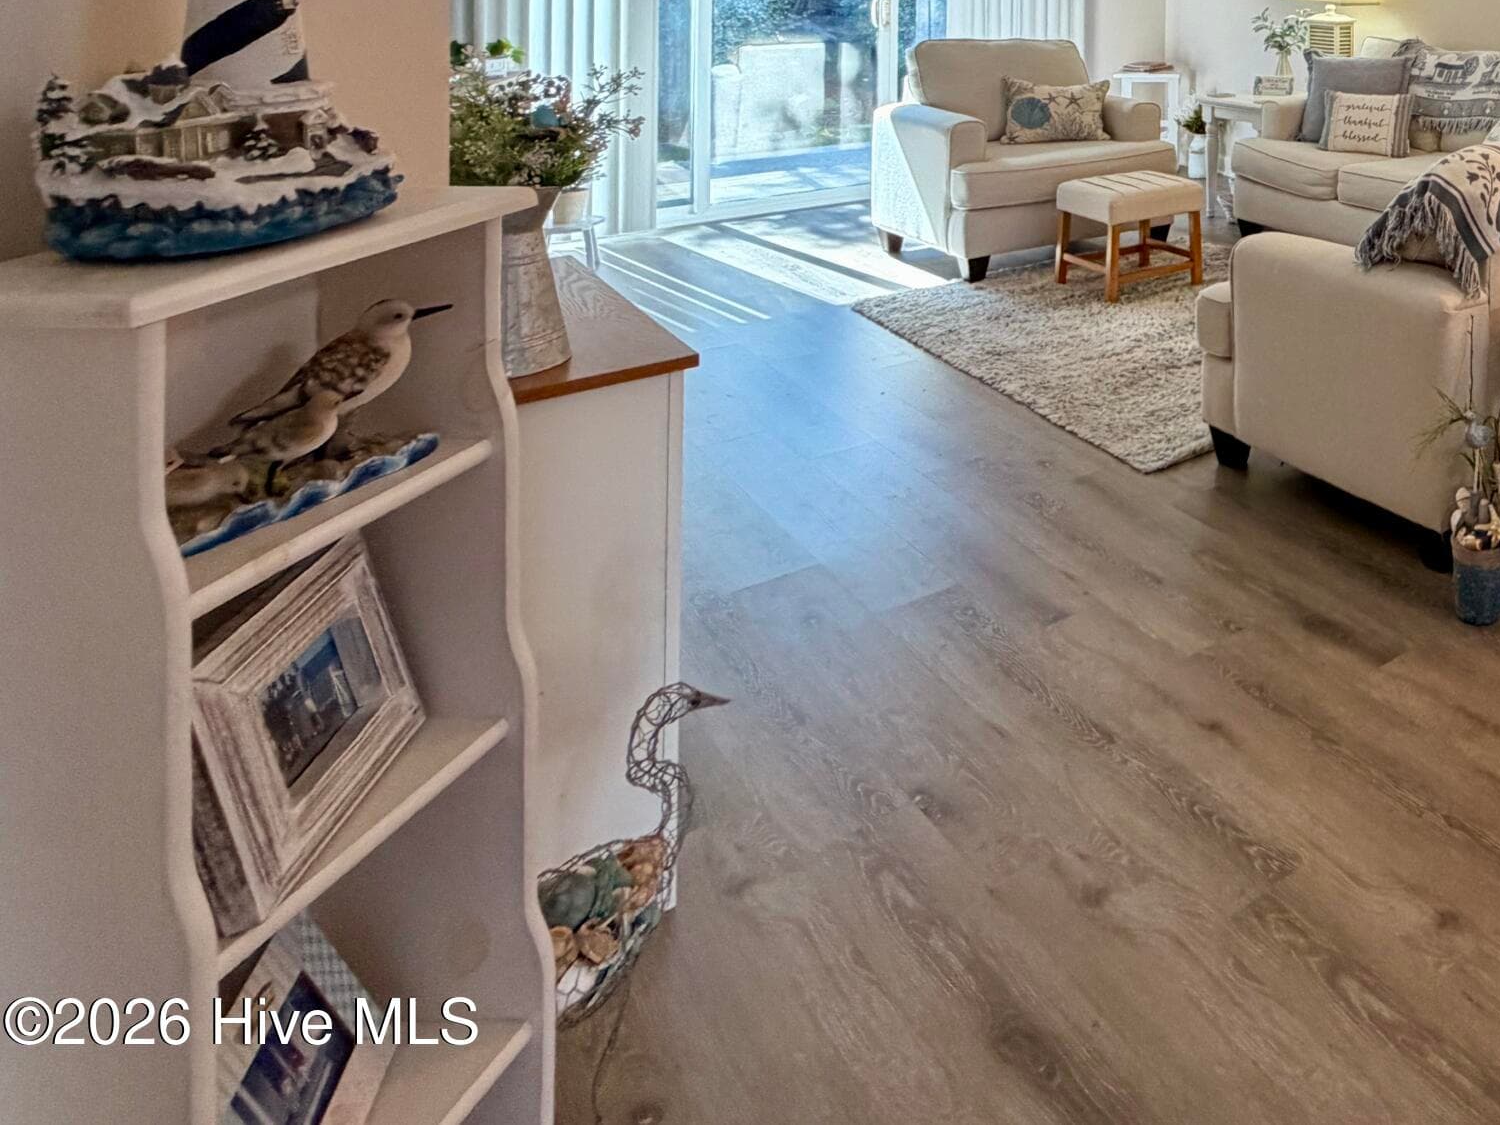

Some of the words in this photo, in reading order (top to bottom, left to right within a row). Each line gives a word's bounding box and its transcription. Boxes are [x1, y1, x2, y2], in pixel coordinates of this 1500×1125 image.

[1341, 103, 1391, 113] grateful
[1339, 116, 1389, 129] thankful
[1338, 130, 1387, 142] blessed
